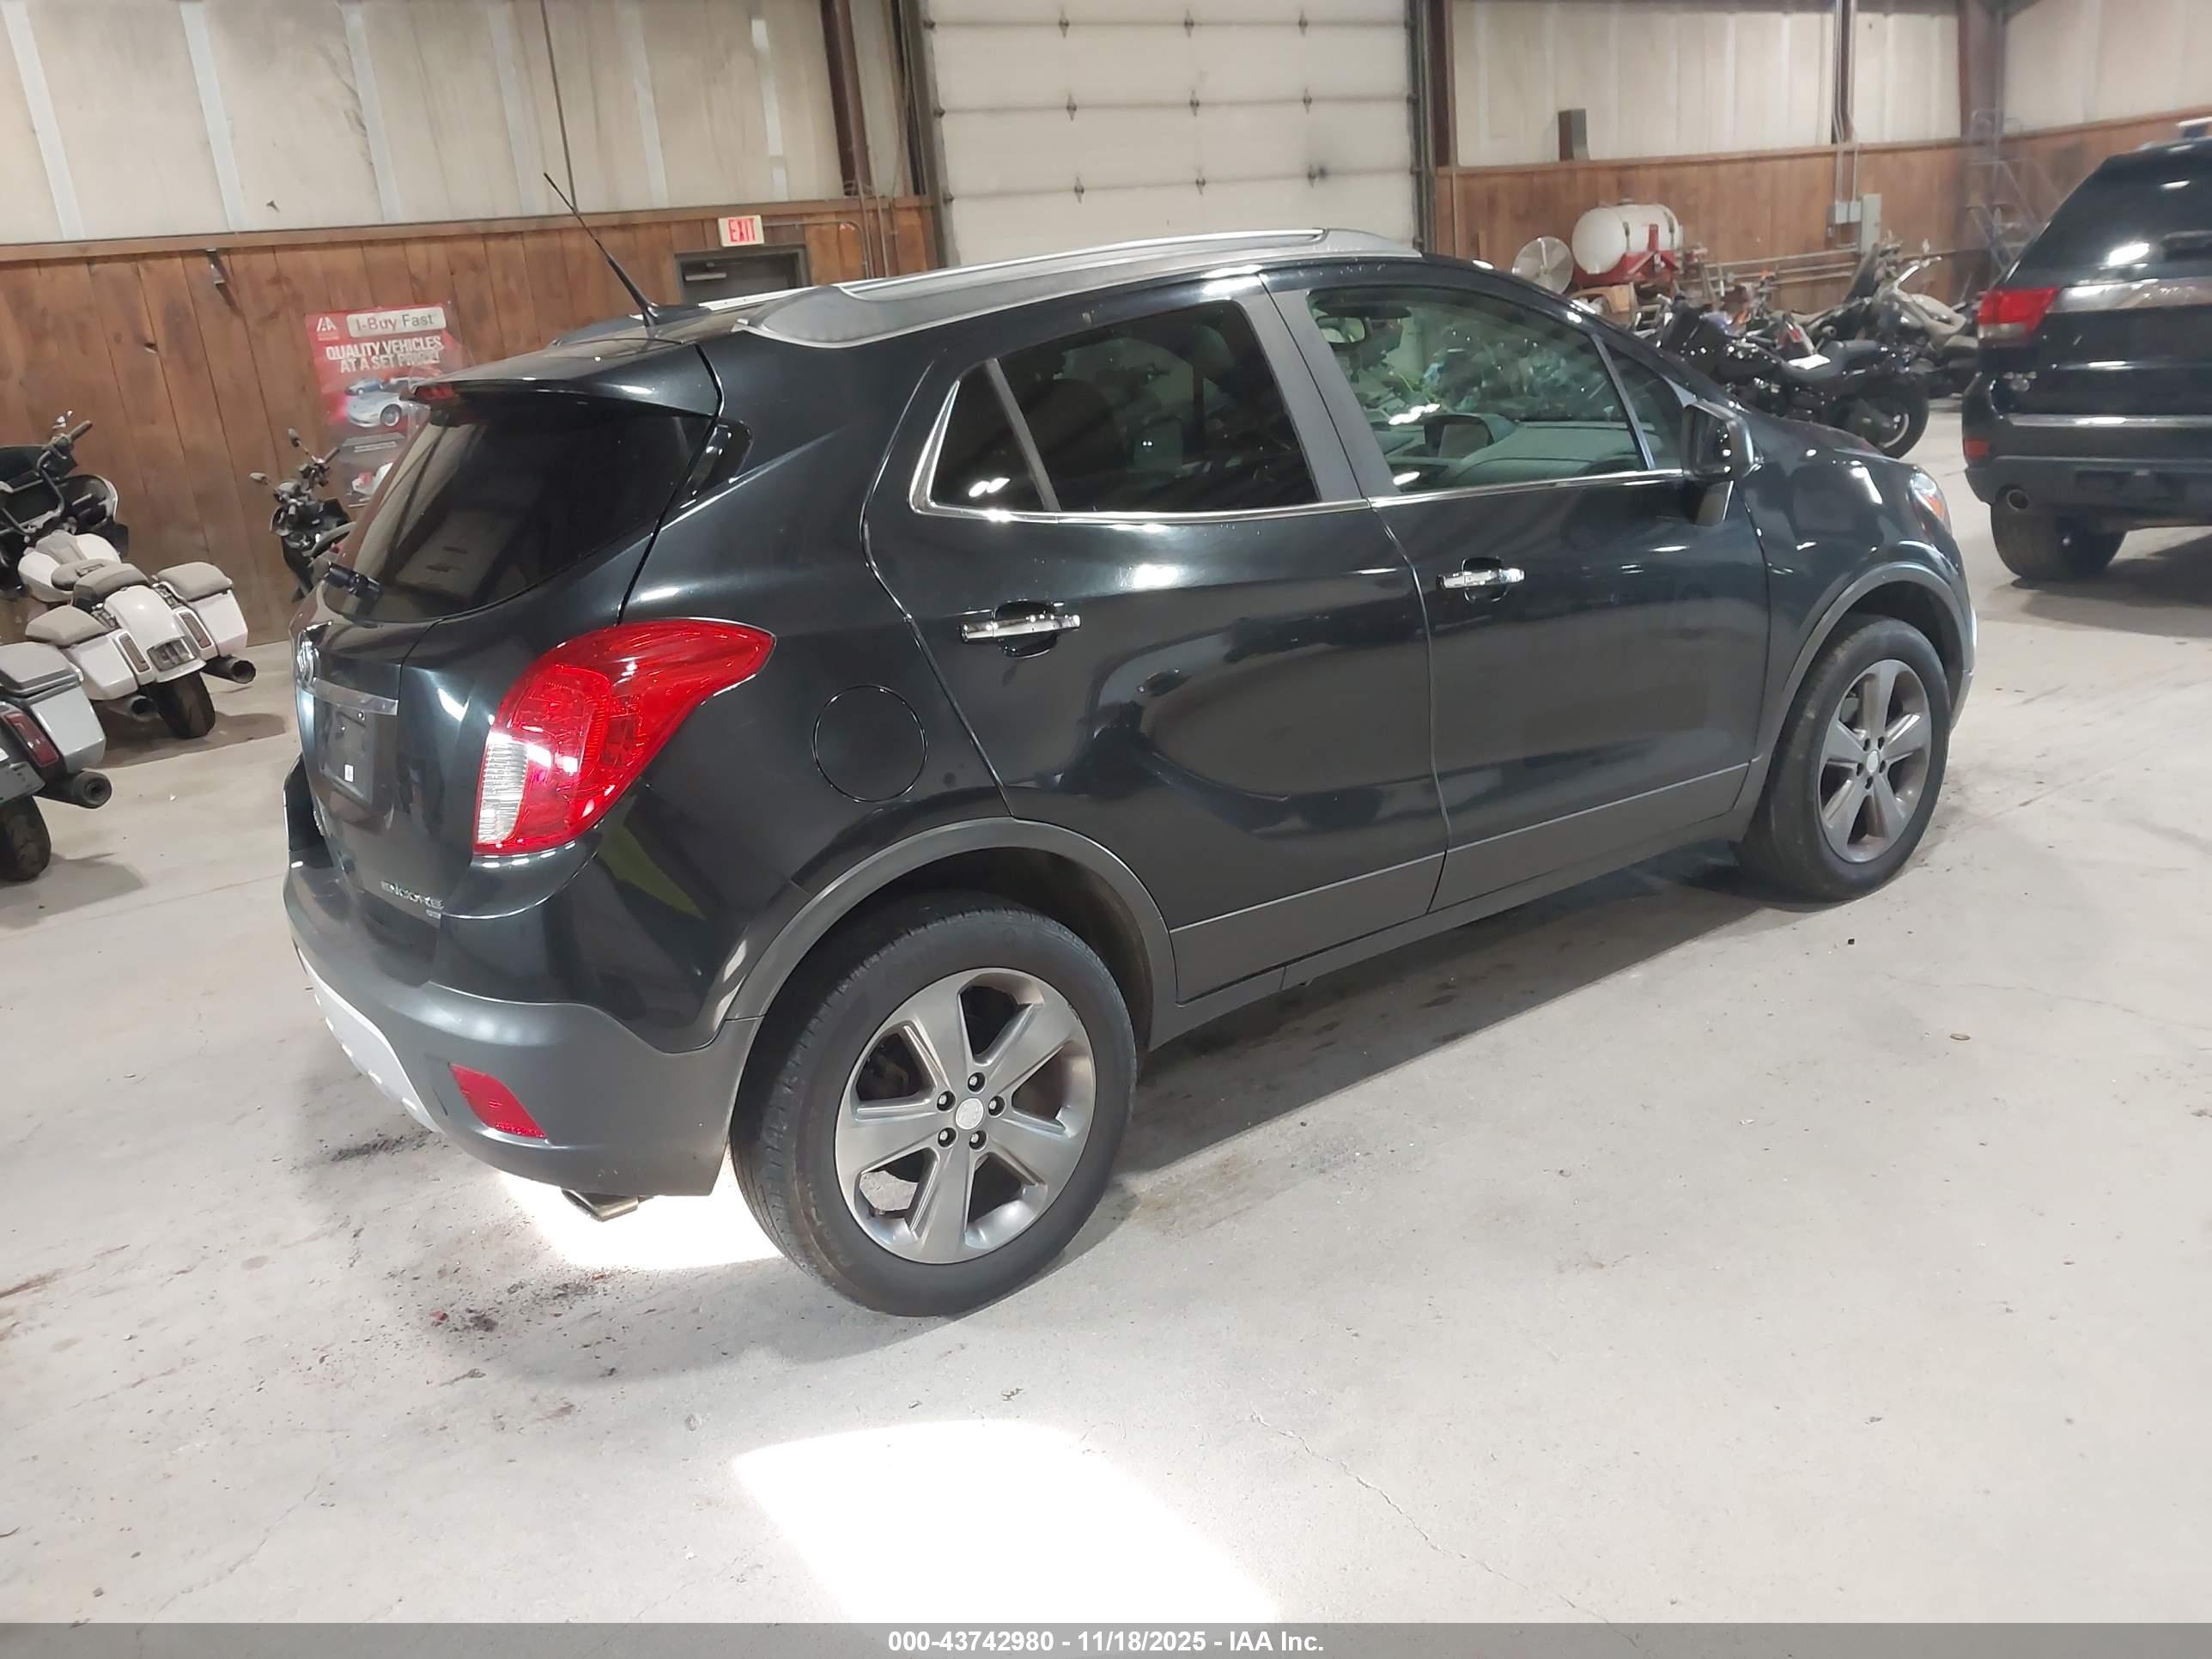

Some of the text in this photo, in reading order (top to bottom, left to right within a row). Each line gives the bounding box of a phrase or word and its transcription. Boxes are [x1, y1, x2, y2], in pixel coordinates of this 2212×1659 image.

[728, 217, 757, 242] EXIT
[356, 313, 434, 331] I-Buy Fast
[325, 335, 445, 361] QUALITY VEHICLES
[340, 357, 357, 374] AT
[359, 356, 370, 372] A
[371, 354, 394, 370] SET
